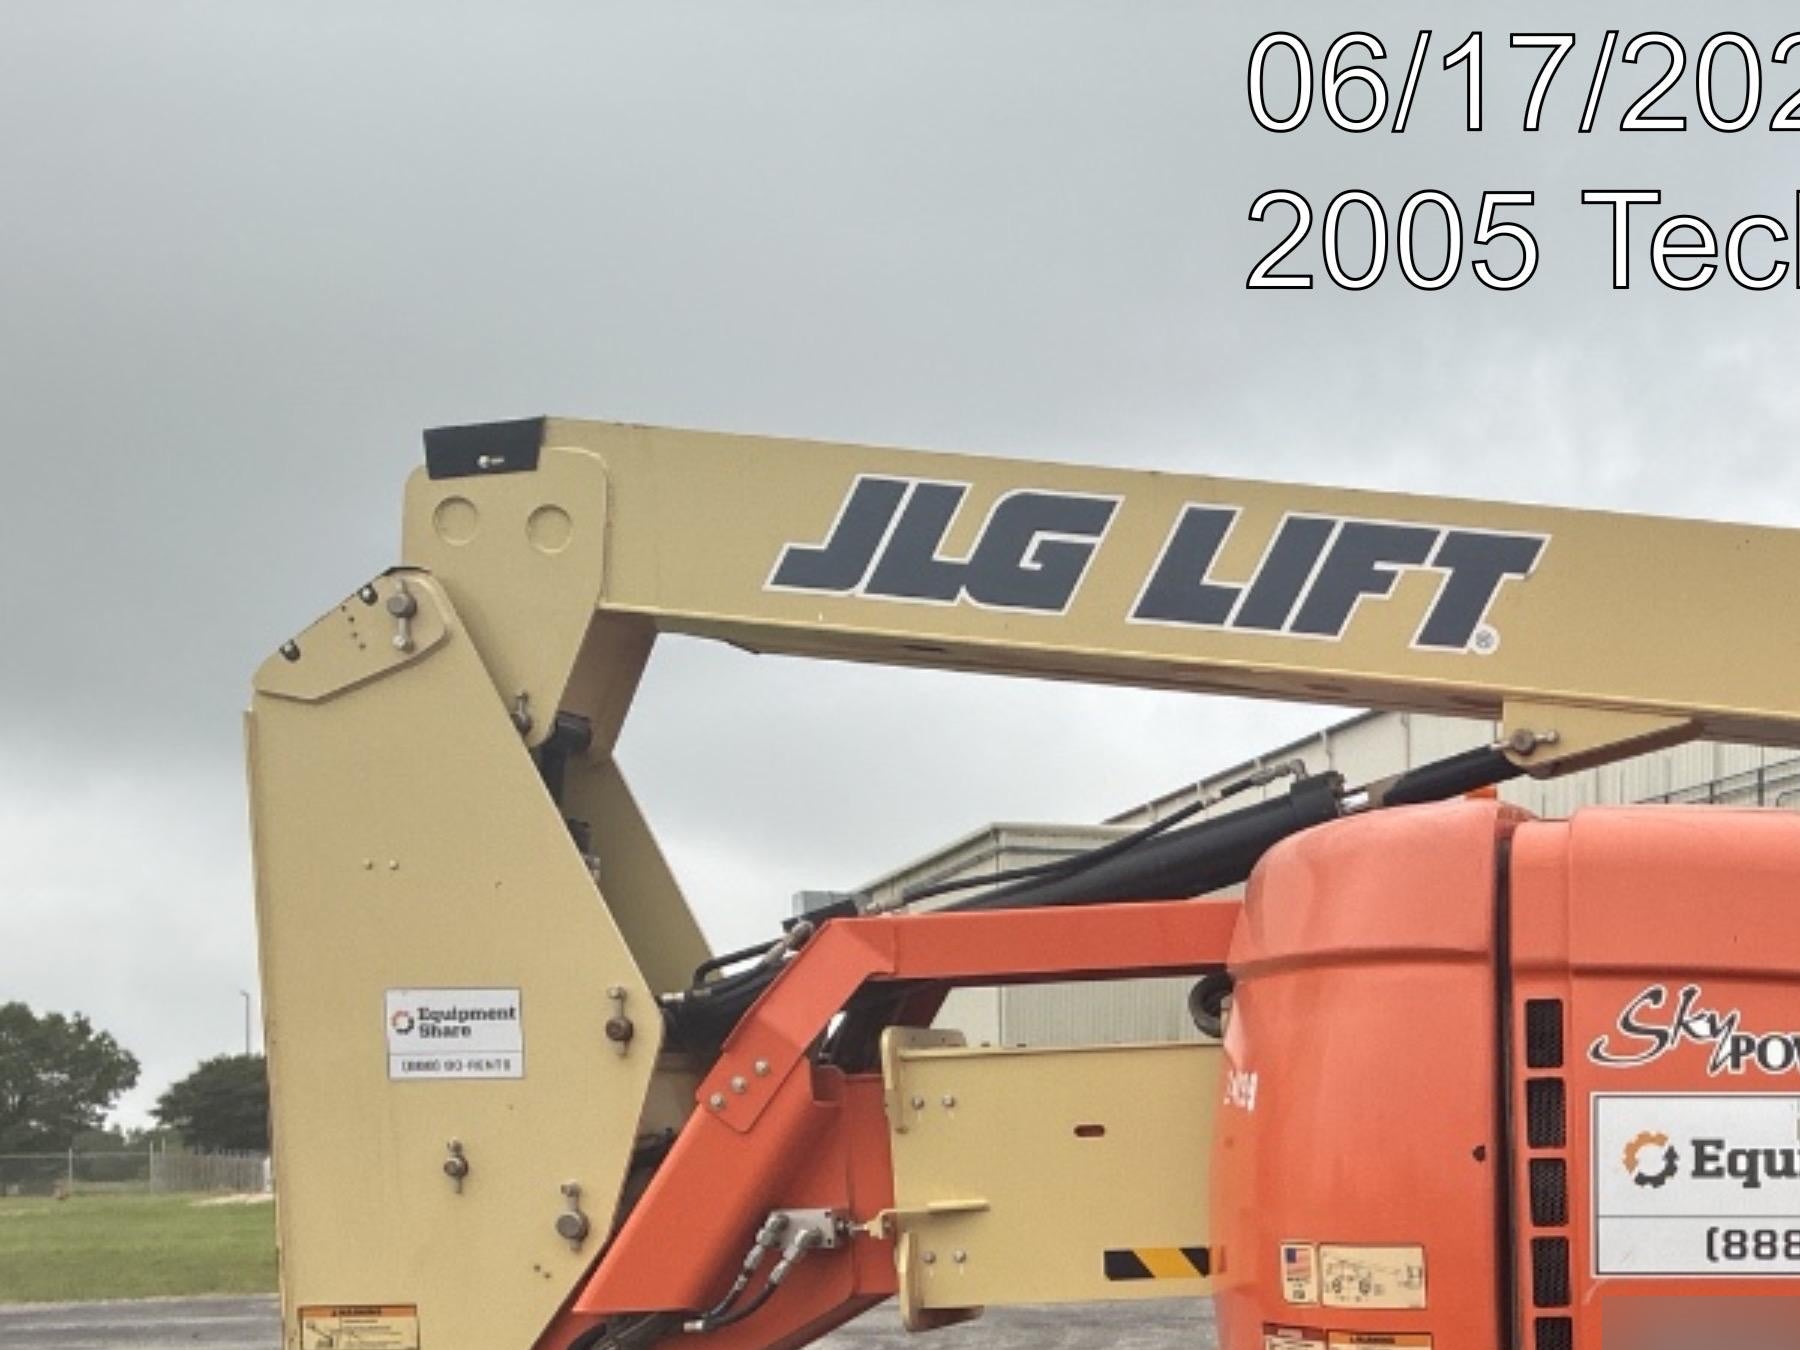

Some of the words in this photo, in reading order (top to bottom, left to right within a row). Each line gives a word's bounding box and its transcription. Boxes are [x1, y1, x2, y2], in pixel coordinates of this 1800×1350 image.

[762, 474, 1125, 615] JLG
[1126, 502, 1552, 652] LIFT
[417, 1005, 517, 1024] Equipment
[419, 1023, 472, 1039] Share
